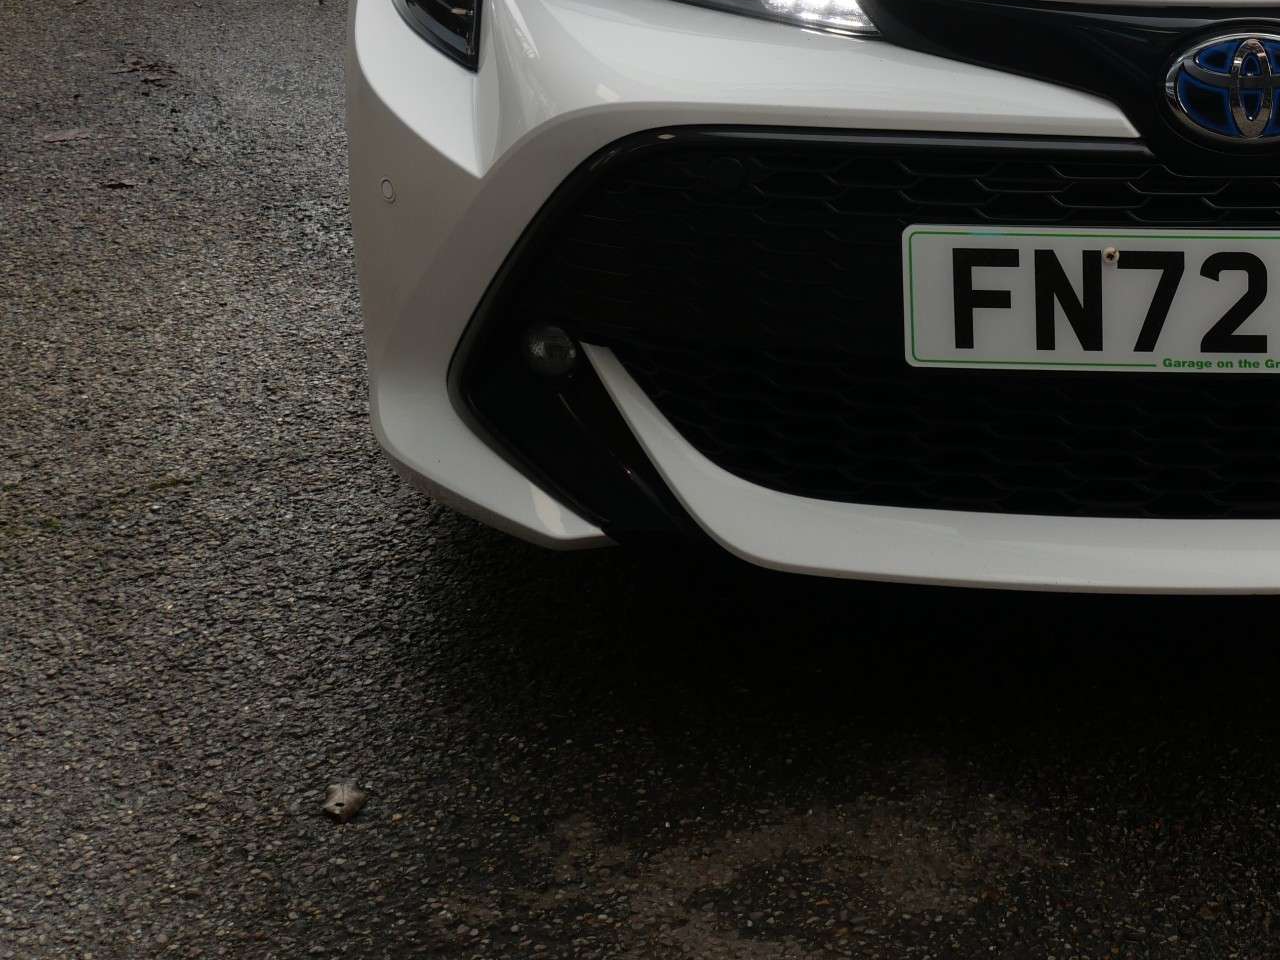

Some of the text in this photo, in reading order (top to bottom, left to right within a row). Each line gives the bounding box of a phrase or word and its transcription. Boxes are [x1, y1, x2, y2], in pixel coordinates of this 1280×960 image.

[952, 247, 1268, 352] FN72
[1162, 357, 1212, 369] Garage
[1216, 360, 1234, 369] on
[1238, 359, 1260, 369] the
